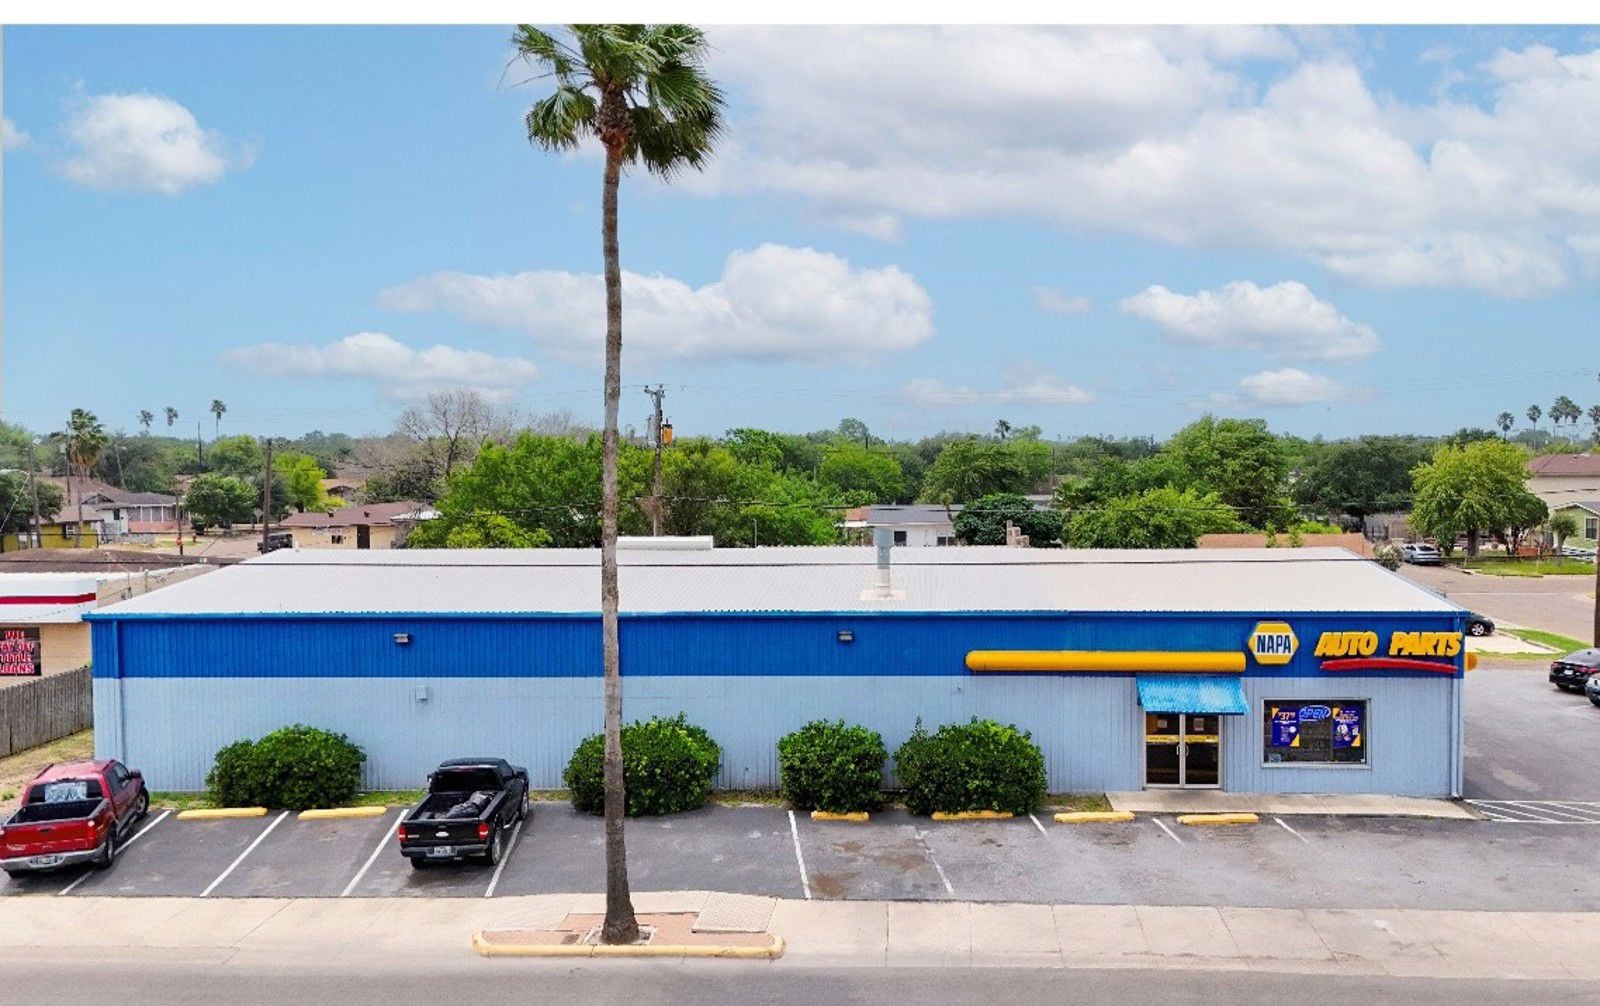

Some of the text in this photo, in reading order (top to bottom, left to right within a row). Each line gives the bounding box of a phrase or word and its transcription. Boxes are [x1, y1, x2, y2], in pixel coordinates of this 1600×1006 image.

[1257, 631, 1462, 656] NAPA AUTO PARTS
[1299, 708, 1328, 719] OPEN
